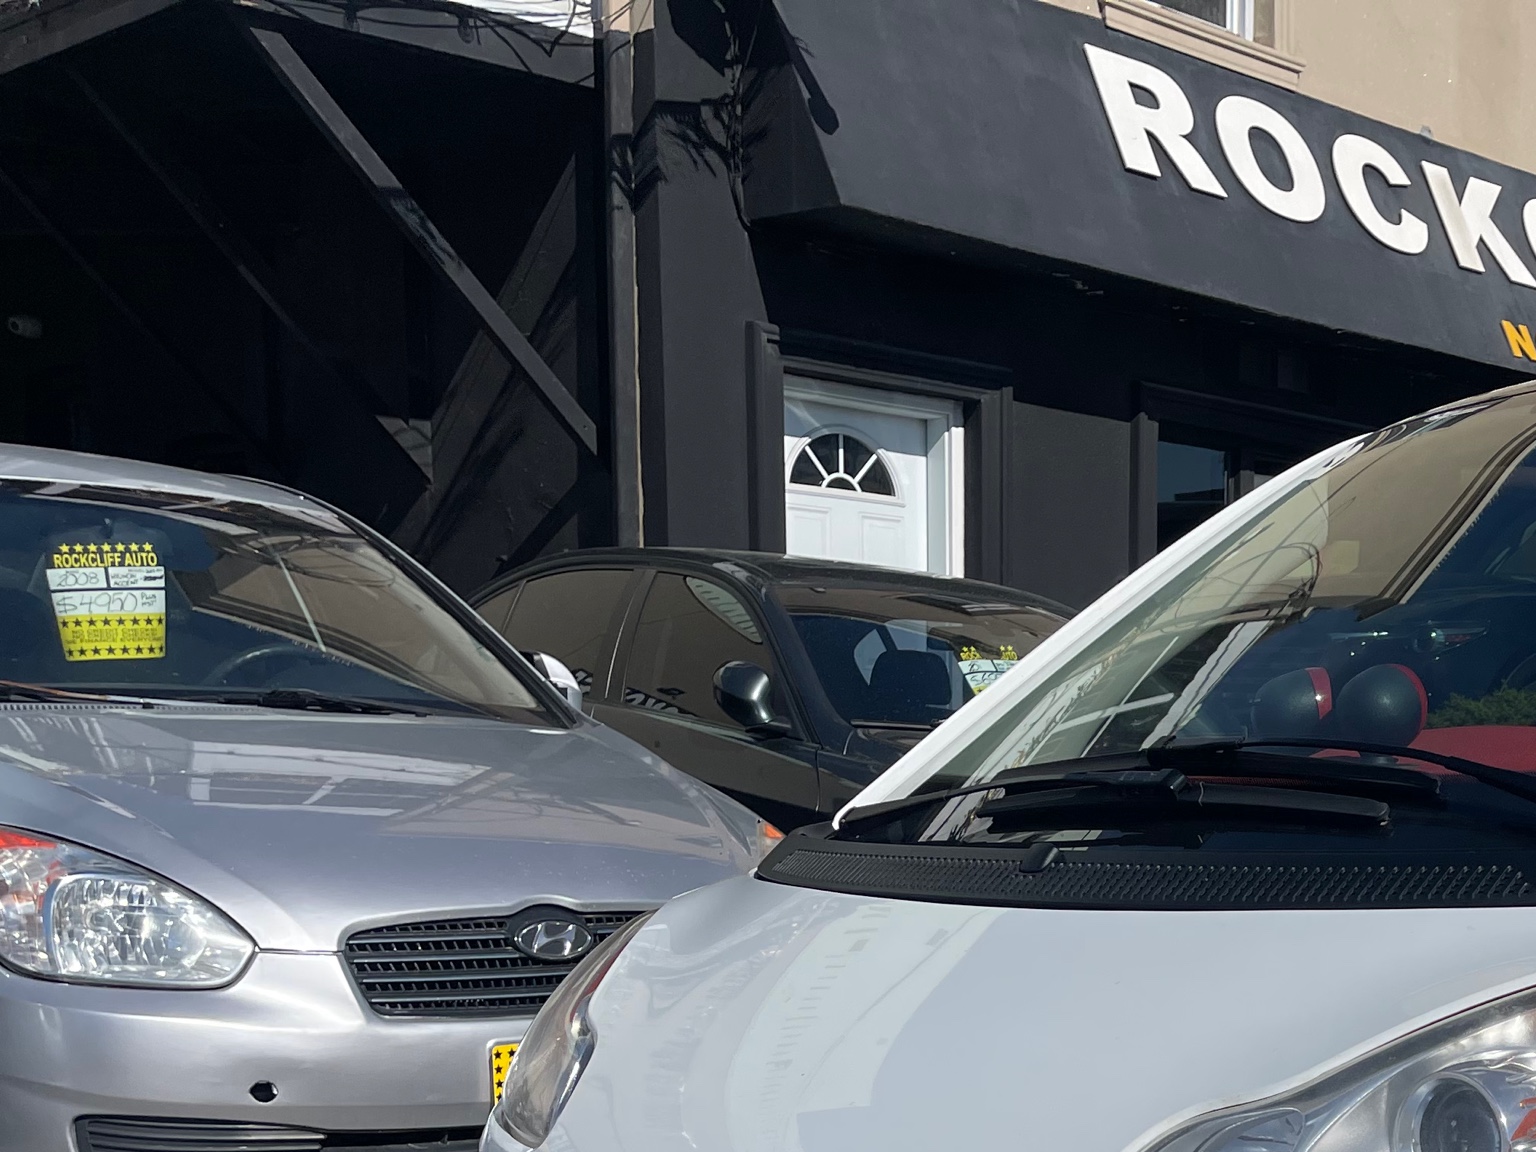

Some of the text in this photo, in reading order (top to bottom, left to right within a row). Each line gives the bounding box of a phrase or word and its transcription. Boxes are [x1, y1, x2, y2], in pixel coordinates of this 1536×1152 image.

[53, 552, 157, 568] ROCKCLIFF AUTO
[57, 572, 100, 587] 2008
